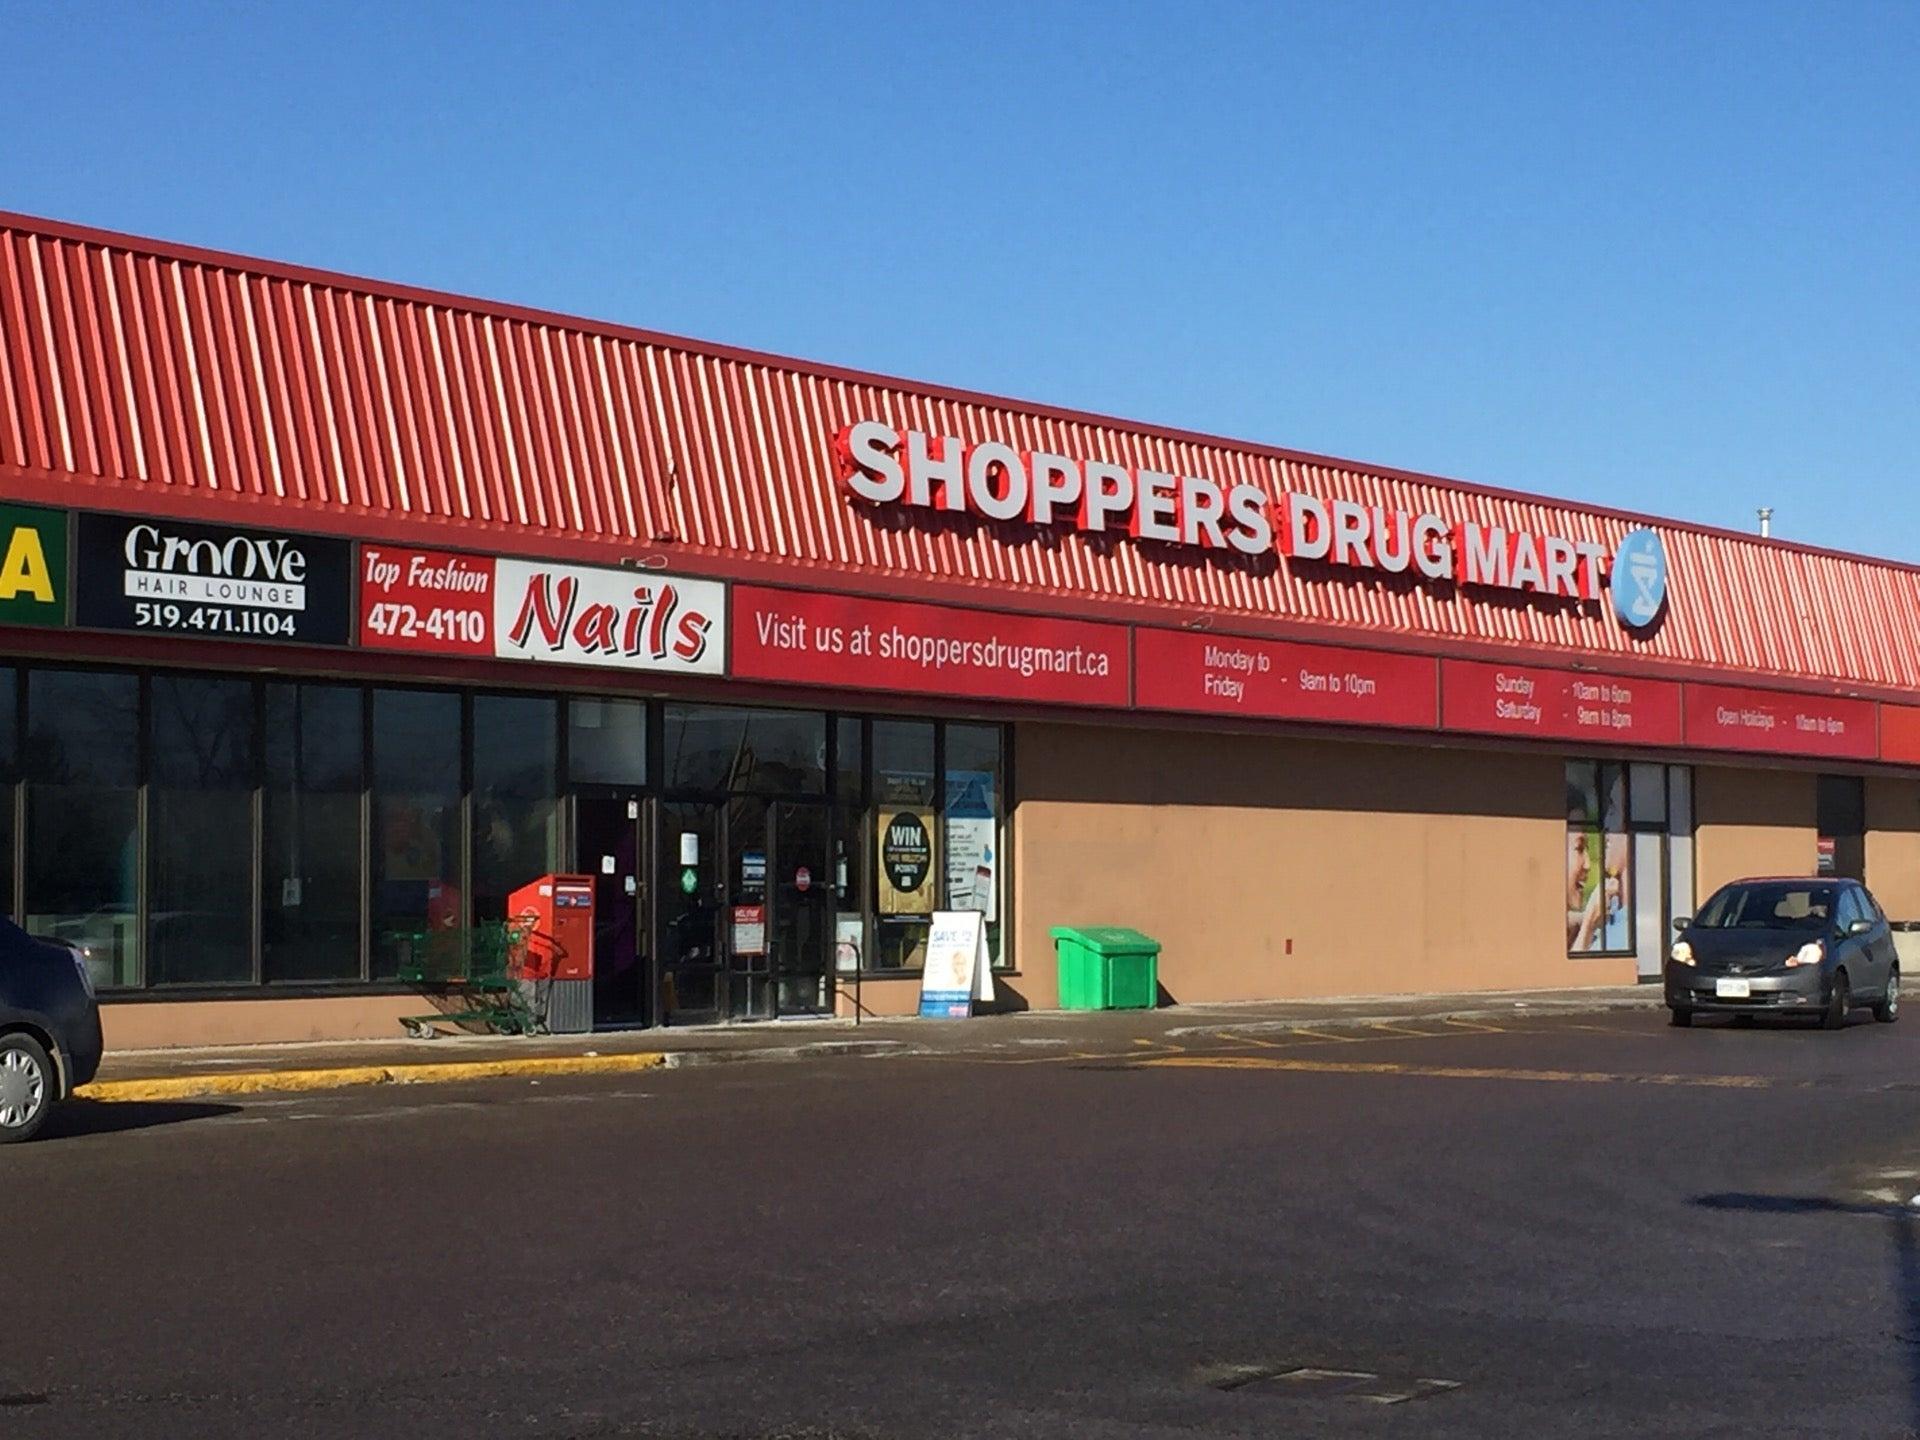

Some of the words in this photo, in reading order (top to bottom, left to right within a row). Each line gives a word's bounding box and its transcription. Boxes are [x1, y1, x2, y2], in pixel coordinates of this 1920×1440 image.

[847, 420, 1272, 555] SHOPPERS
[1288, 491, 1453, 580] DRUG
[1464, 521, 1607, 600] MART
[365, 551, 400, 593] Top
[408, 556, 489, 594] Fashion
[137, 577, 188, 596] HAIR
[205, 582, 294, 604] LOUNGE
[134, 602, 297, 637] 519.471.1104
[366, 602, 486, 644] 472-4110
[507, 573, 712, 663] Nails
[755, 611, 807, 651] Visit
[815, 626, 843, 654] us
[849, 624, 872, 657] at
[879, 625, 1110, 678] shoppersdrugmart.ca
[1204, 645, 1255, 676] Monday
[1257, 652, 1271, 673] to
[1204, 673, 1245, 703] Friday
[1299, 669, 1327, 692] 9am
[1328, 673, 1341, 693] to
[1344, 673, 1376, 698] 10pm
[1495, 672, 1536, 700] Sunday
[1601, 684, 1611, 702] to
[1495, 698, 1542, 725] Saturday
[1601, 709, 1611, 726] to
[891, 826, 922, 847] WIN
